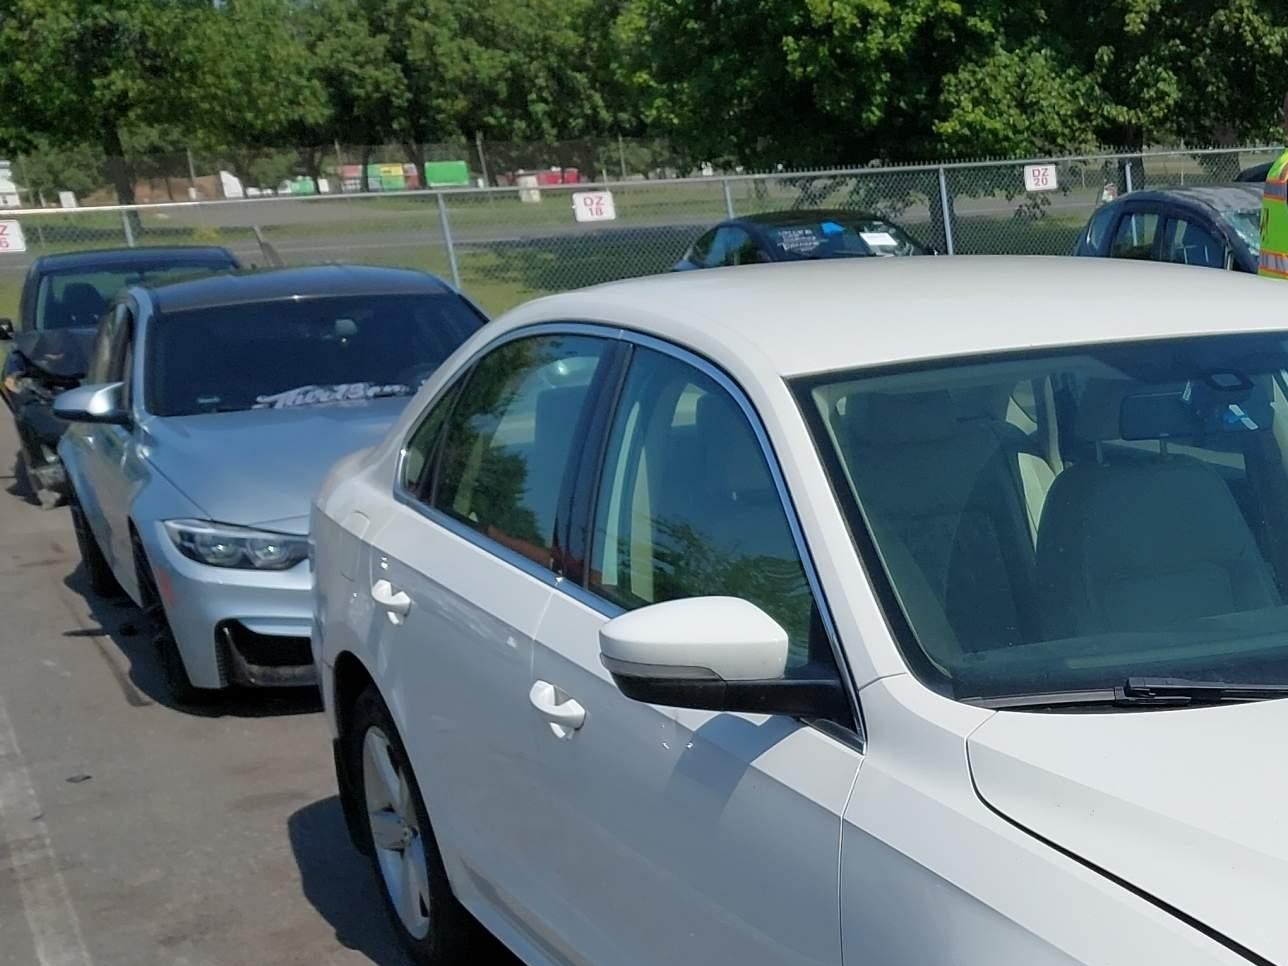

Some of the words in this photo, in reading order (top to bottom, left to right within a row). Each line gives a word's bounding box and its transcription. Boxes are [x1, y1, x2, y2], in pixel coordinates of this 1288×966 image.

[1032, 168, 1049, 178] DZ
[1033, 177, 1049, 186] 20
[583, 195, 605, 207] DZ
[588, 207, 604, 217] 18
